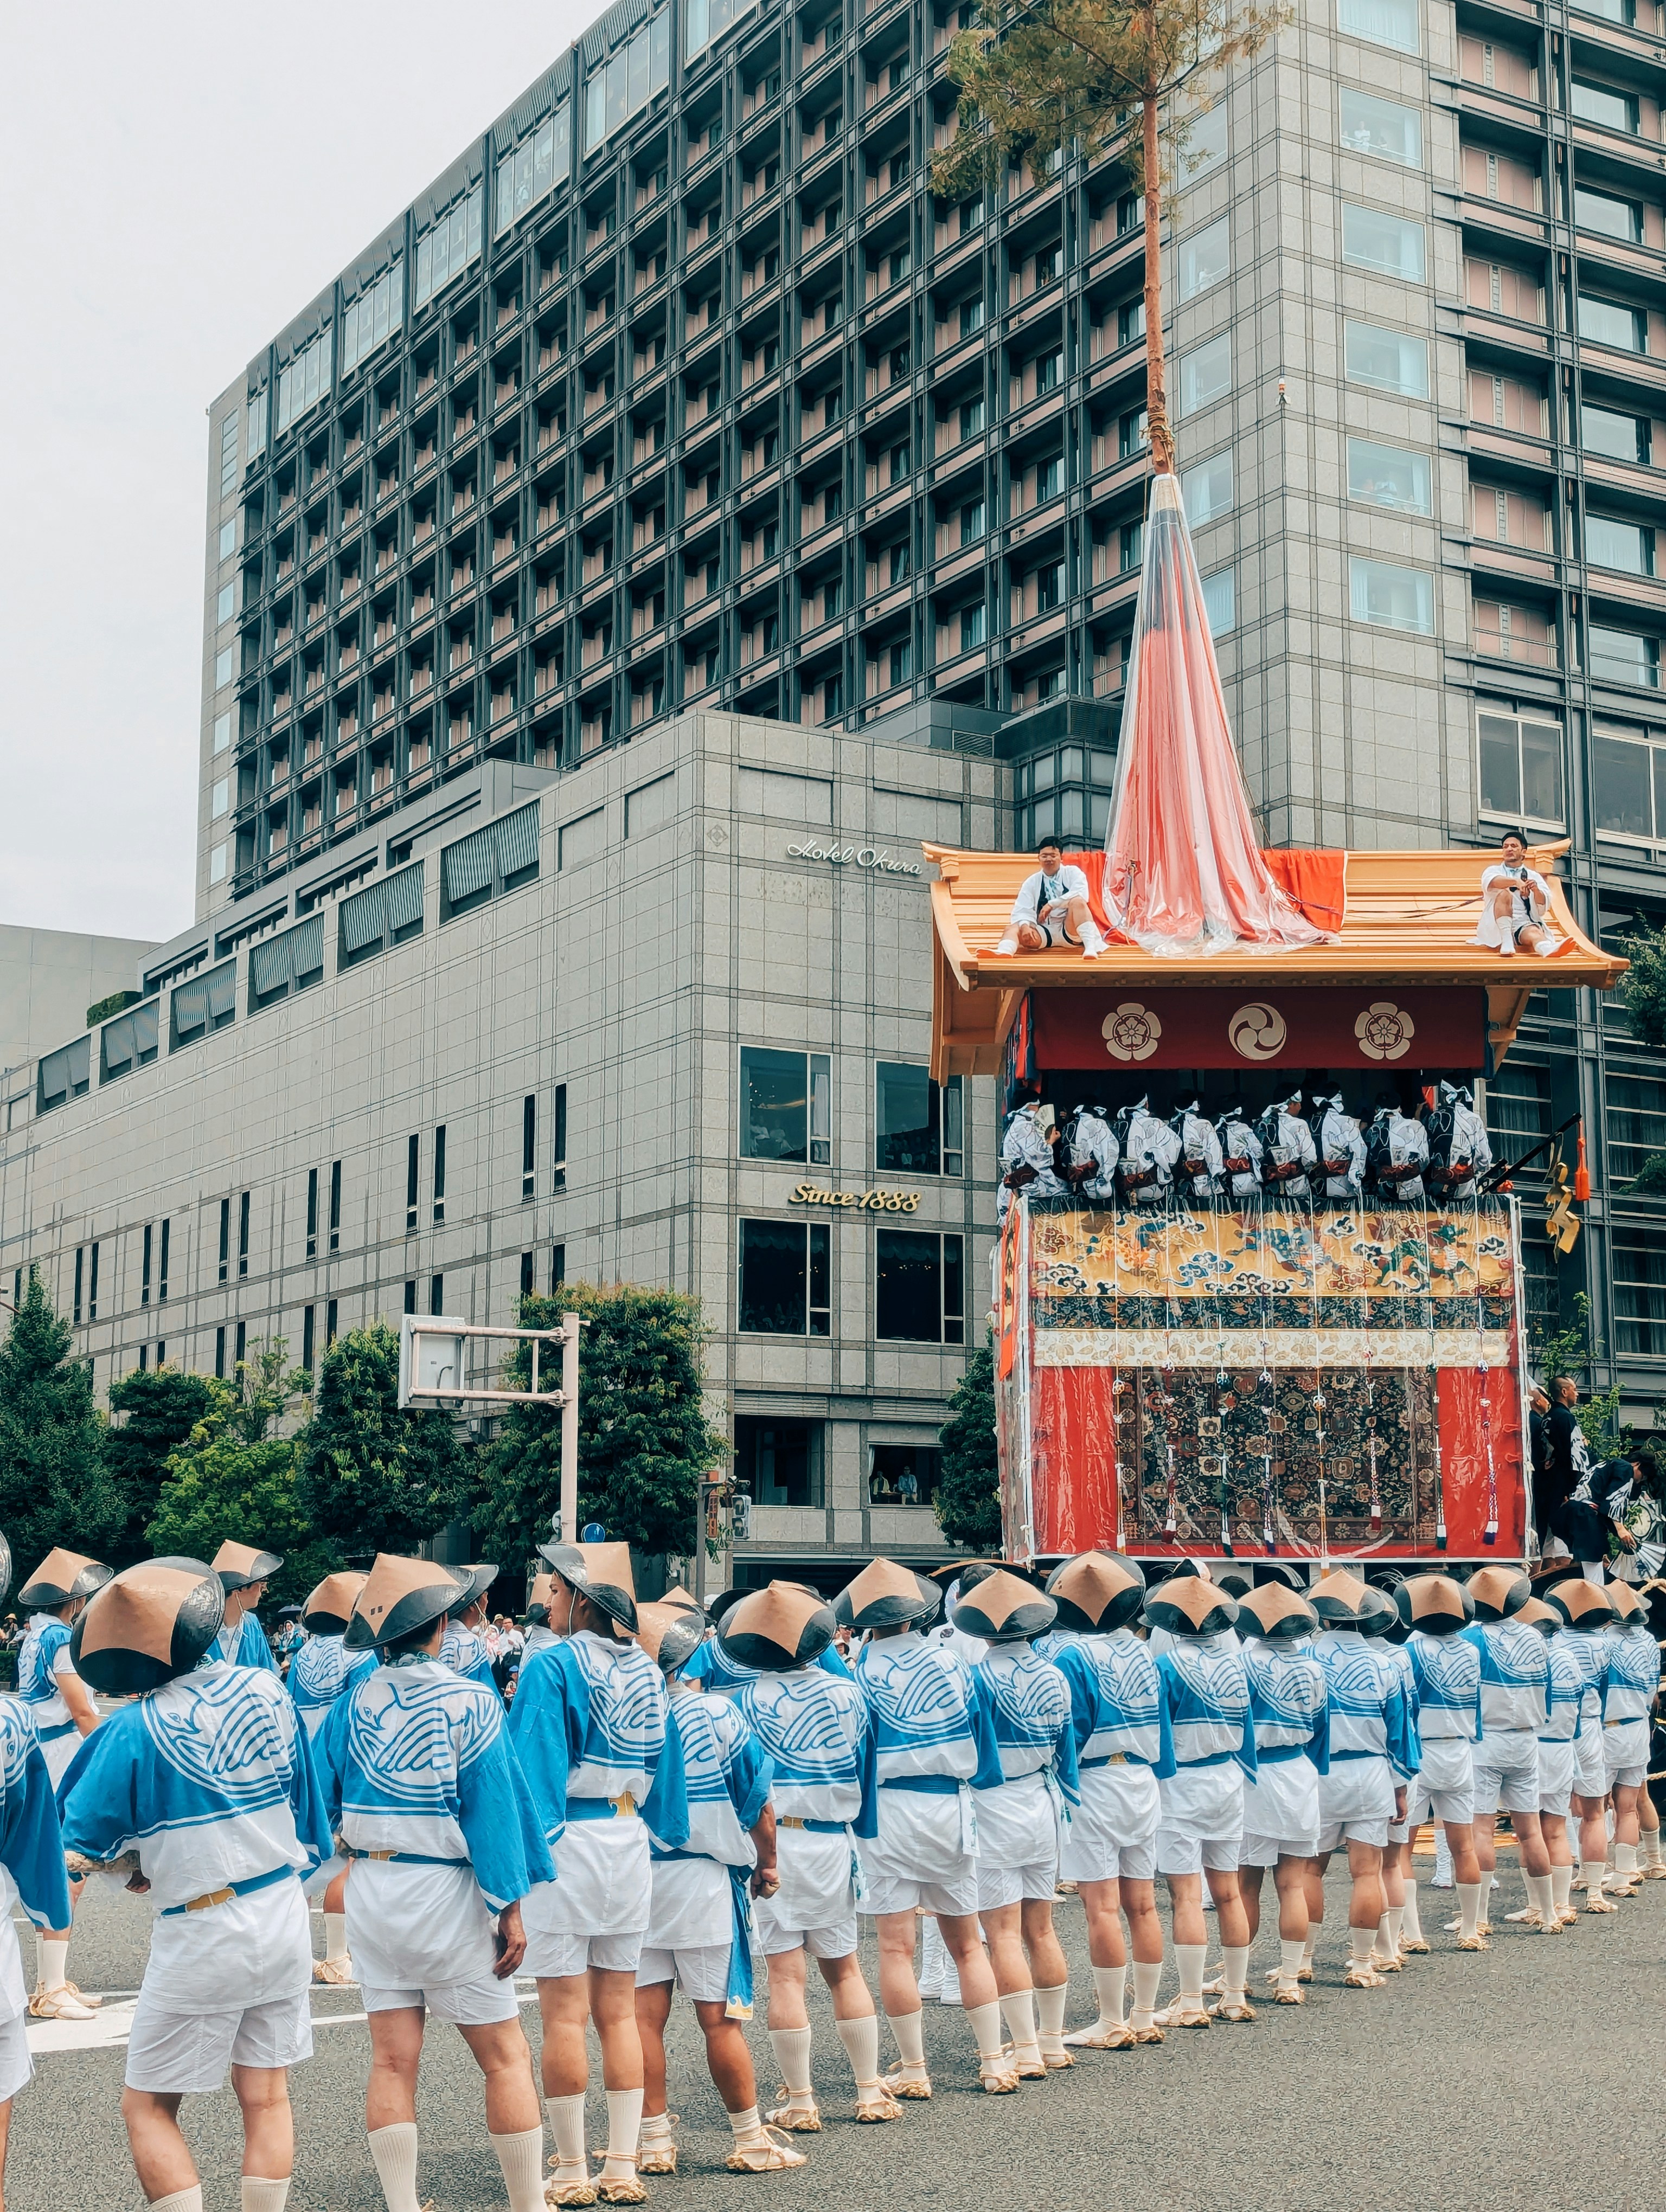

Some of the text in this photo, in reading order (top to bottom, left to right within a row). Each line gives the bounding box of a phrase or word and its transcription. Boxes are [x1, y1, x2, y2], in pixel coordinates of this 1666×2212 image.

[787, 839, 923, 875] Hotel Okura
[789, 1182, 921, 1212] Since 1888
